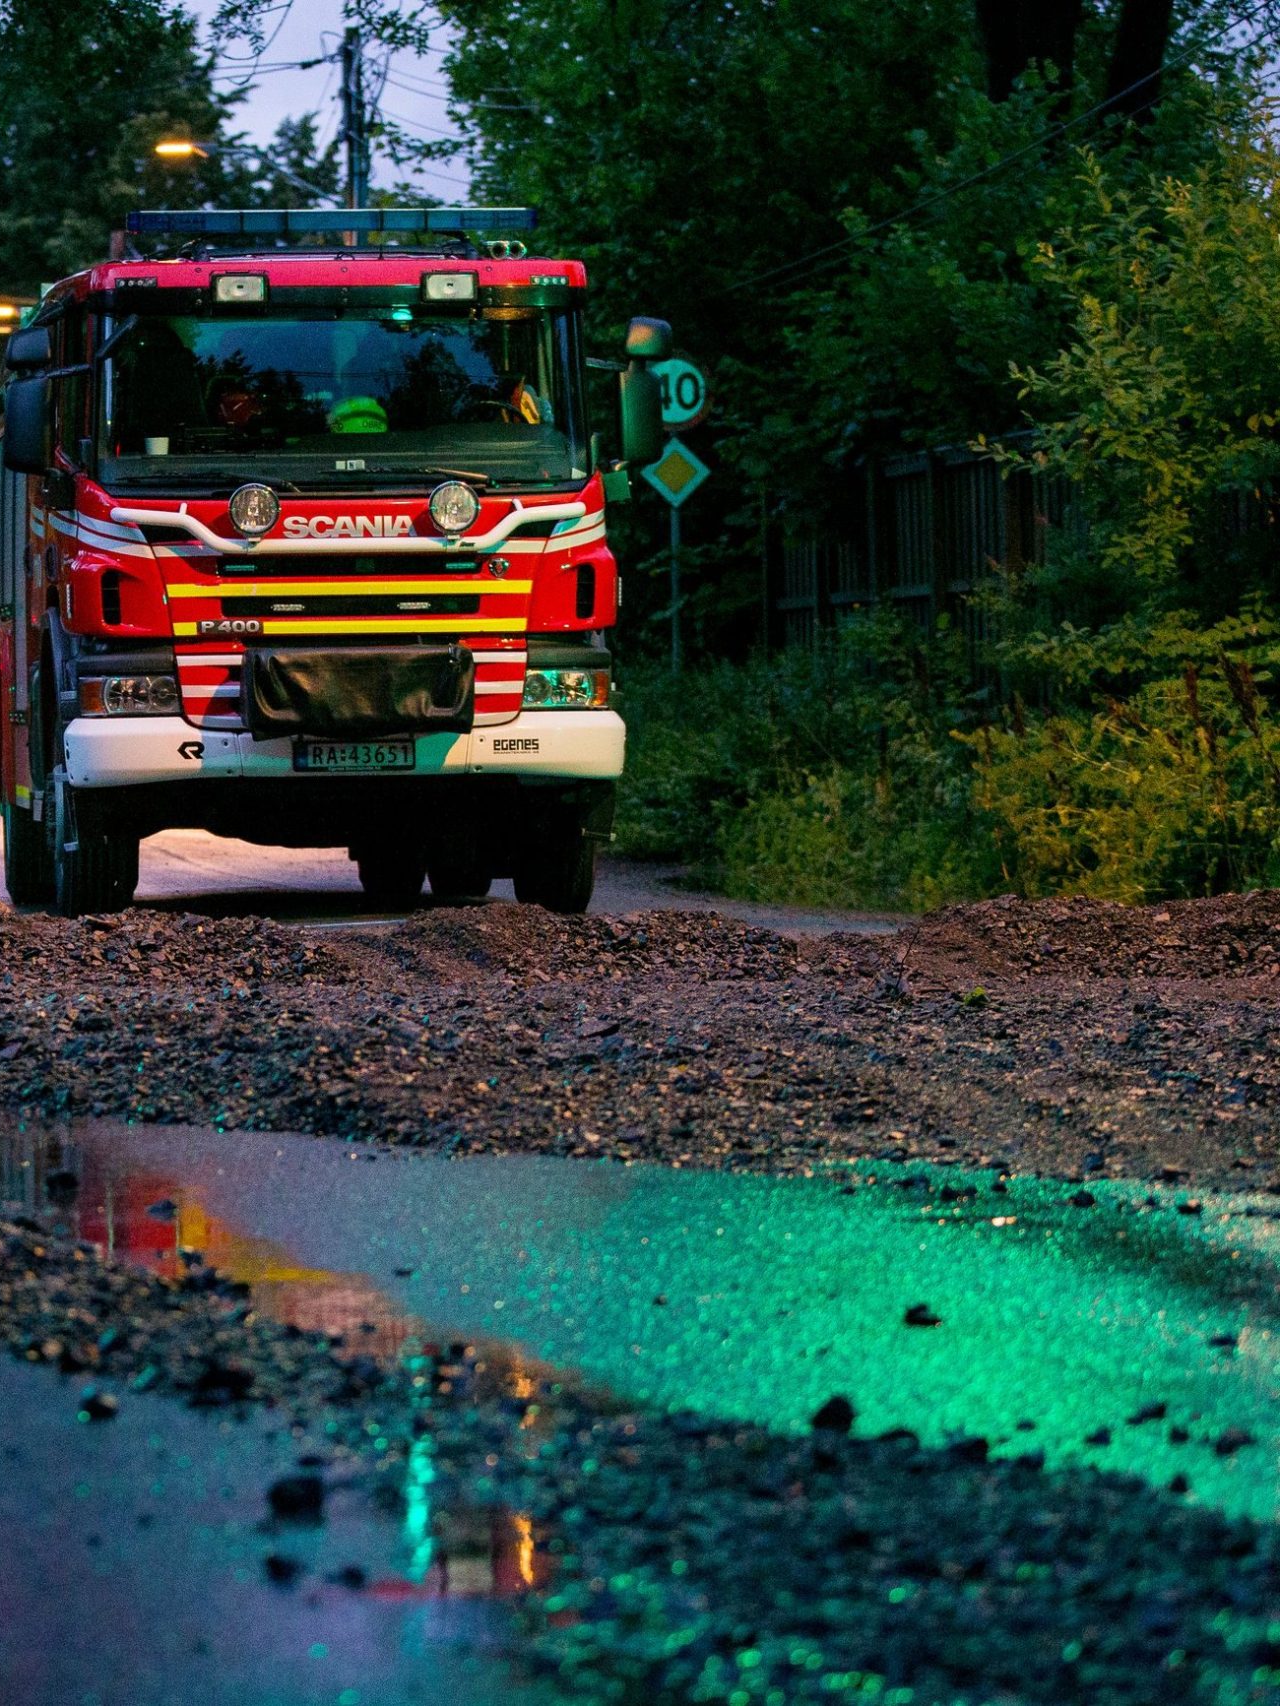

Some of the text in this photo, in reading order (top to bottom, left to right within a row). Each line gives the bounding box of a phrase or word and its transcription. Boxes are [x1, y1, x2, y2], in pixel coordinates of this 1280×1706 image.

[282, 515, 418, 538] SCANIA
[201, 620, 260, 633] P 400
[348, 745, 409, 764] 43651
